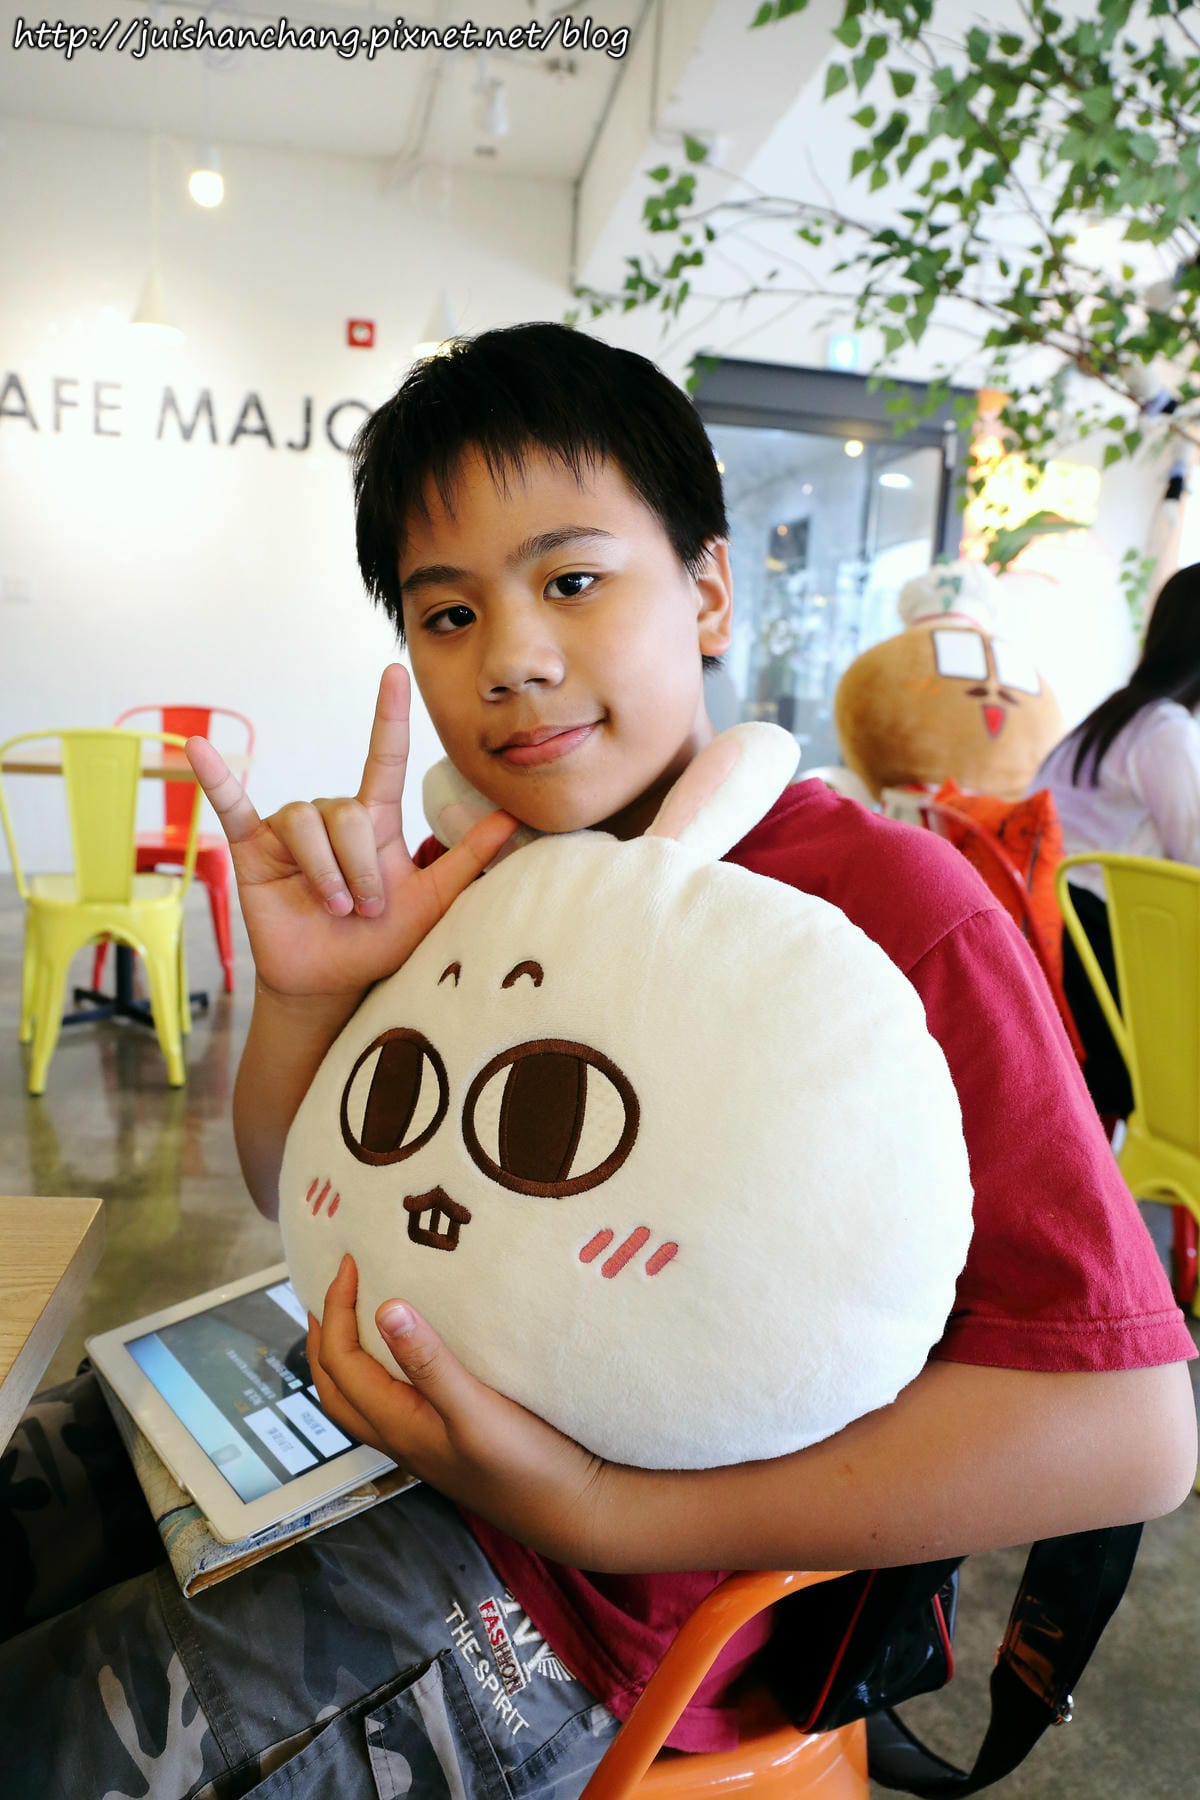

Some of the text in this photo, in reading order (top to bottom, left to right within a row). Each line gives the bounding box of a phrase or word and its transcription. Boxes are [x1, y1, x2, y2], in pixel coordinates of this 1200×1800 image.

[0, 372, 122, 437] AFE
[445, 1601, 481, 1668] THE
[473, 1659, 530, 1735] SPIRIT
[479, 1600, 525, 1696] FASHION
